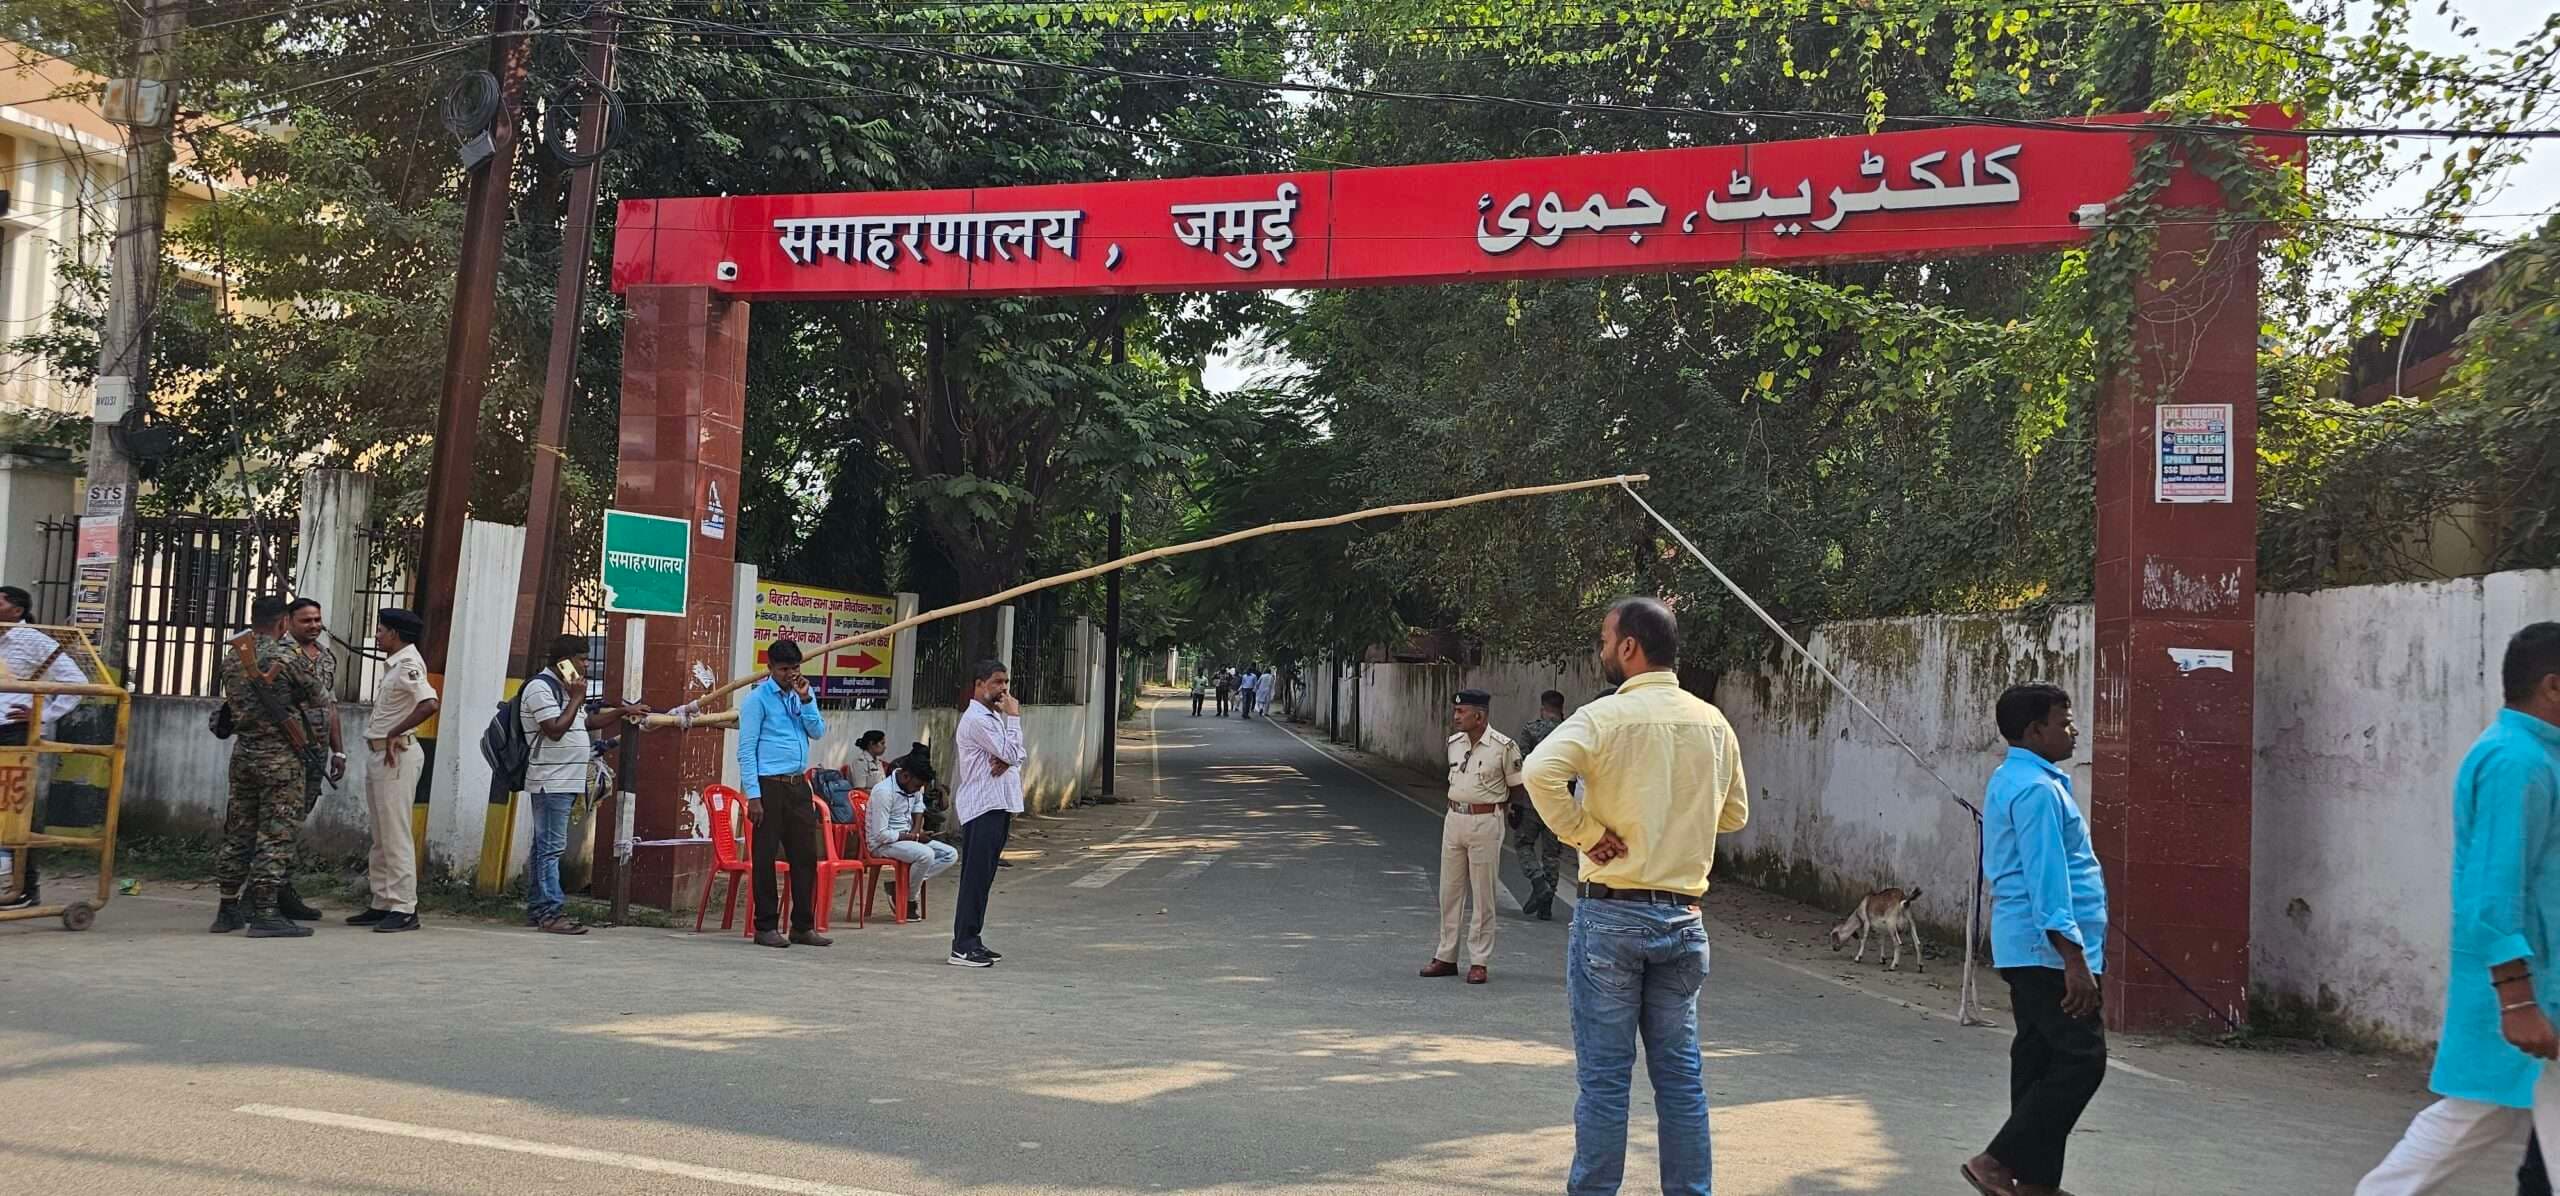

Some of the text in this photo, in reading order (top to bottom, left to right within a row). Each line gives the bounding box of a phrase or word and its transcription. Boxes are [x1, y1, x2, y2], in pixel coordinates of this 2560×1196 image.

[773, 210, 1083, 271] समाहरणालय
[1169, 182, 1300, 270] जमुई
[2182, 407, 2224, 419] ALMIGHTY
[2176, 434, 2223, 444] ENGLISH
[2163, 466, 2178, 474] SSC
[90, 486, 121, 500] STS
[607, 550, 685, 575] समाहरणालय
